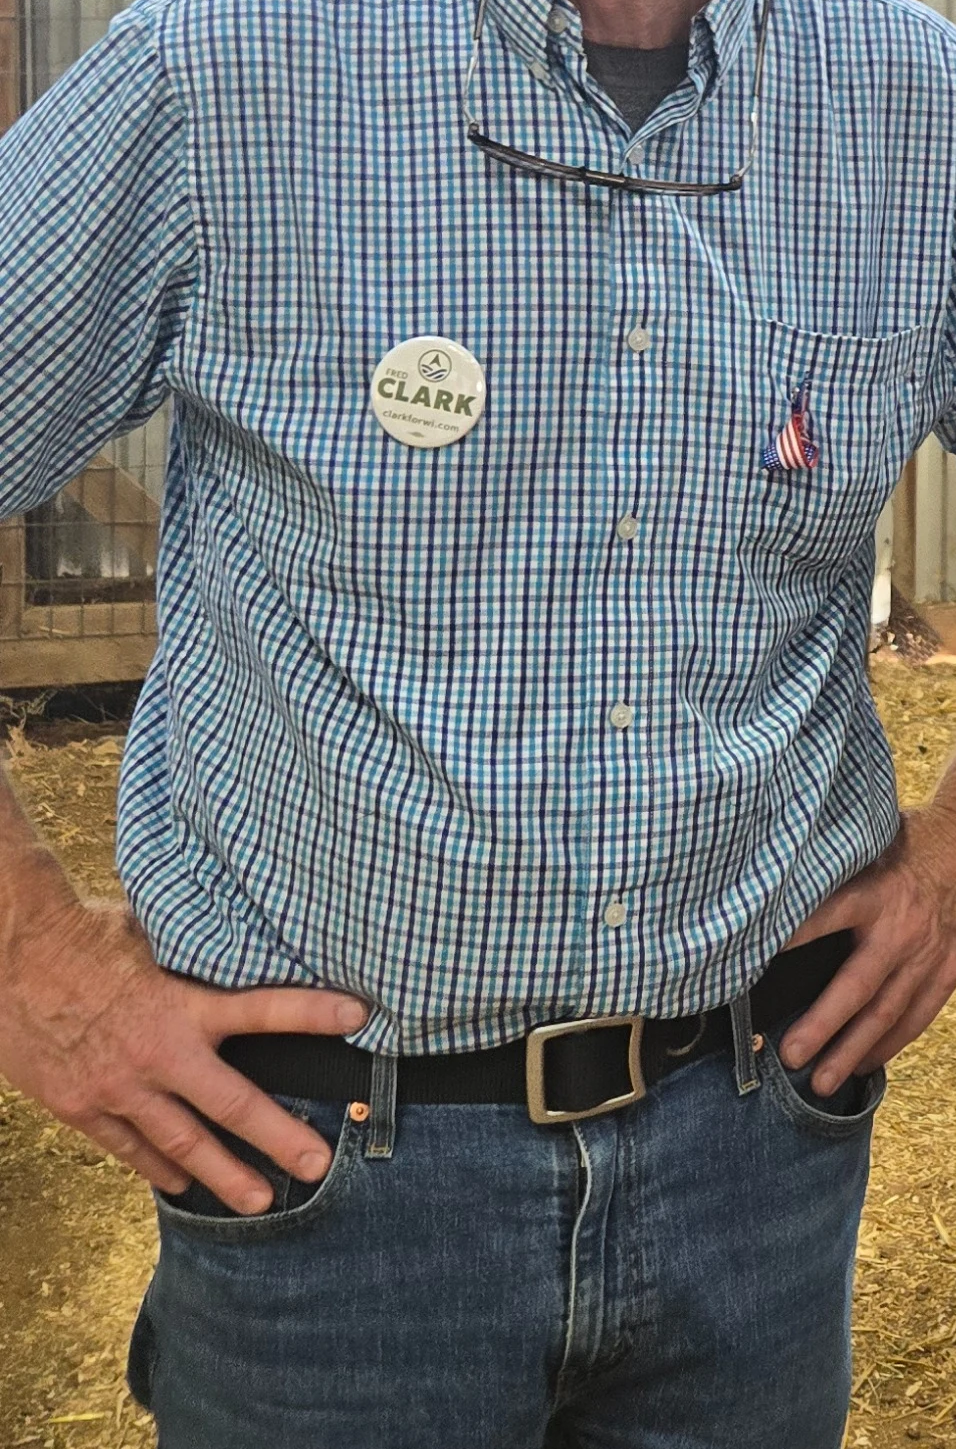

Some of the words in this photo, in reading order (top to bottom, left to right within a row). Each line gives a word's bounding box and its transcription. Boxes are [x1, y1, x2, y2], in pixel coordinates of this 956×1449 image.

[386, 368, 409, 380] FRED
[377, 377, 477, 417] CLARK
[382, 410, 460, 432] clarkforwi.com
